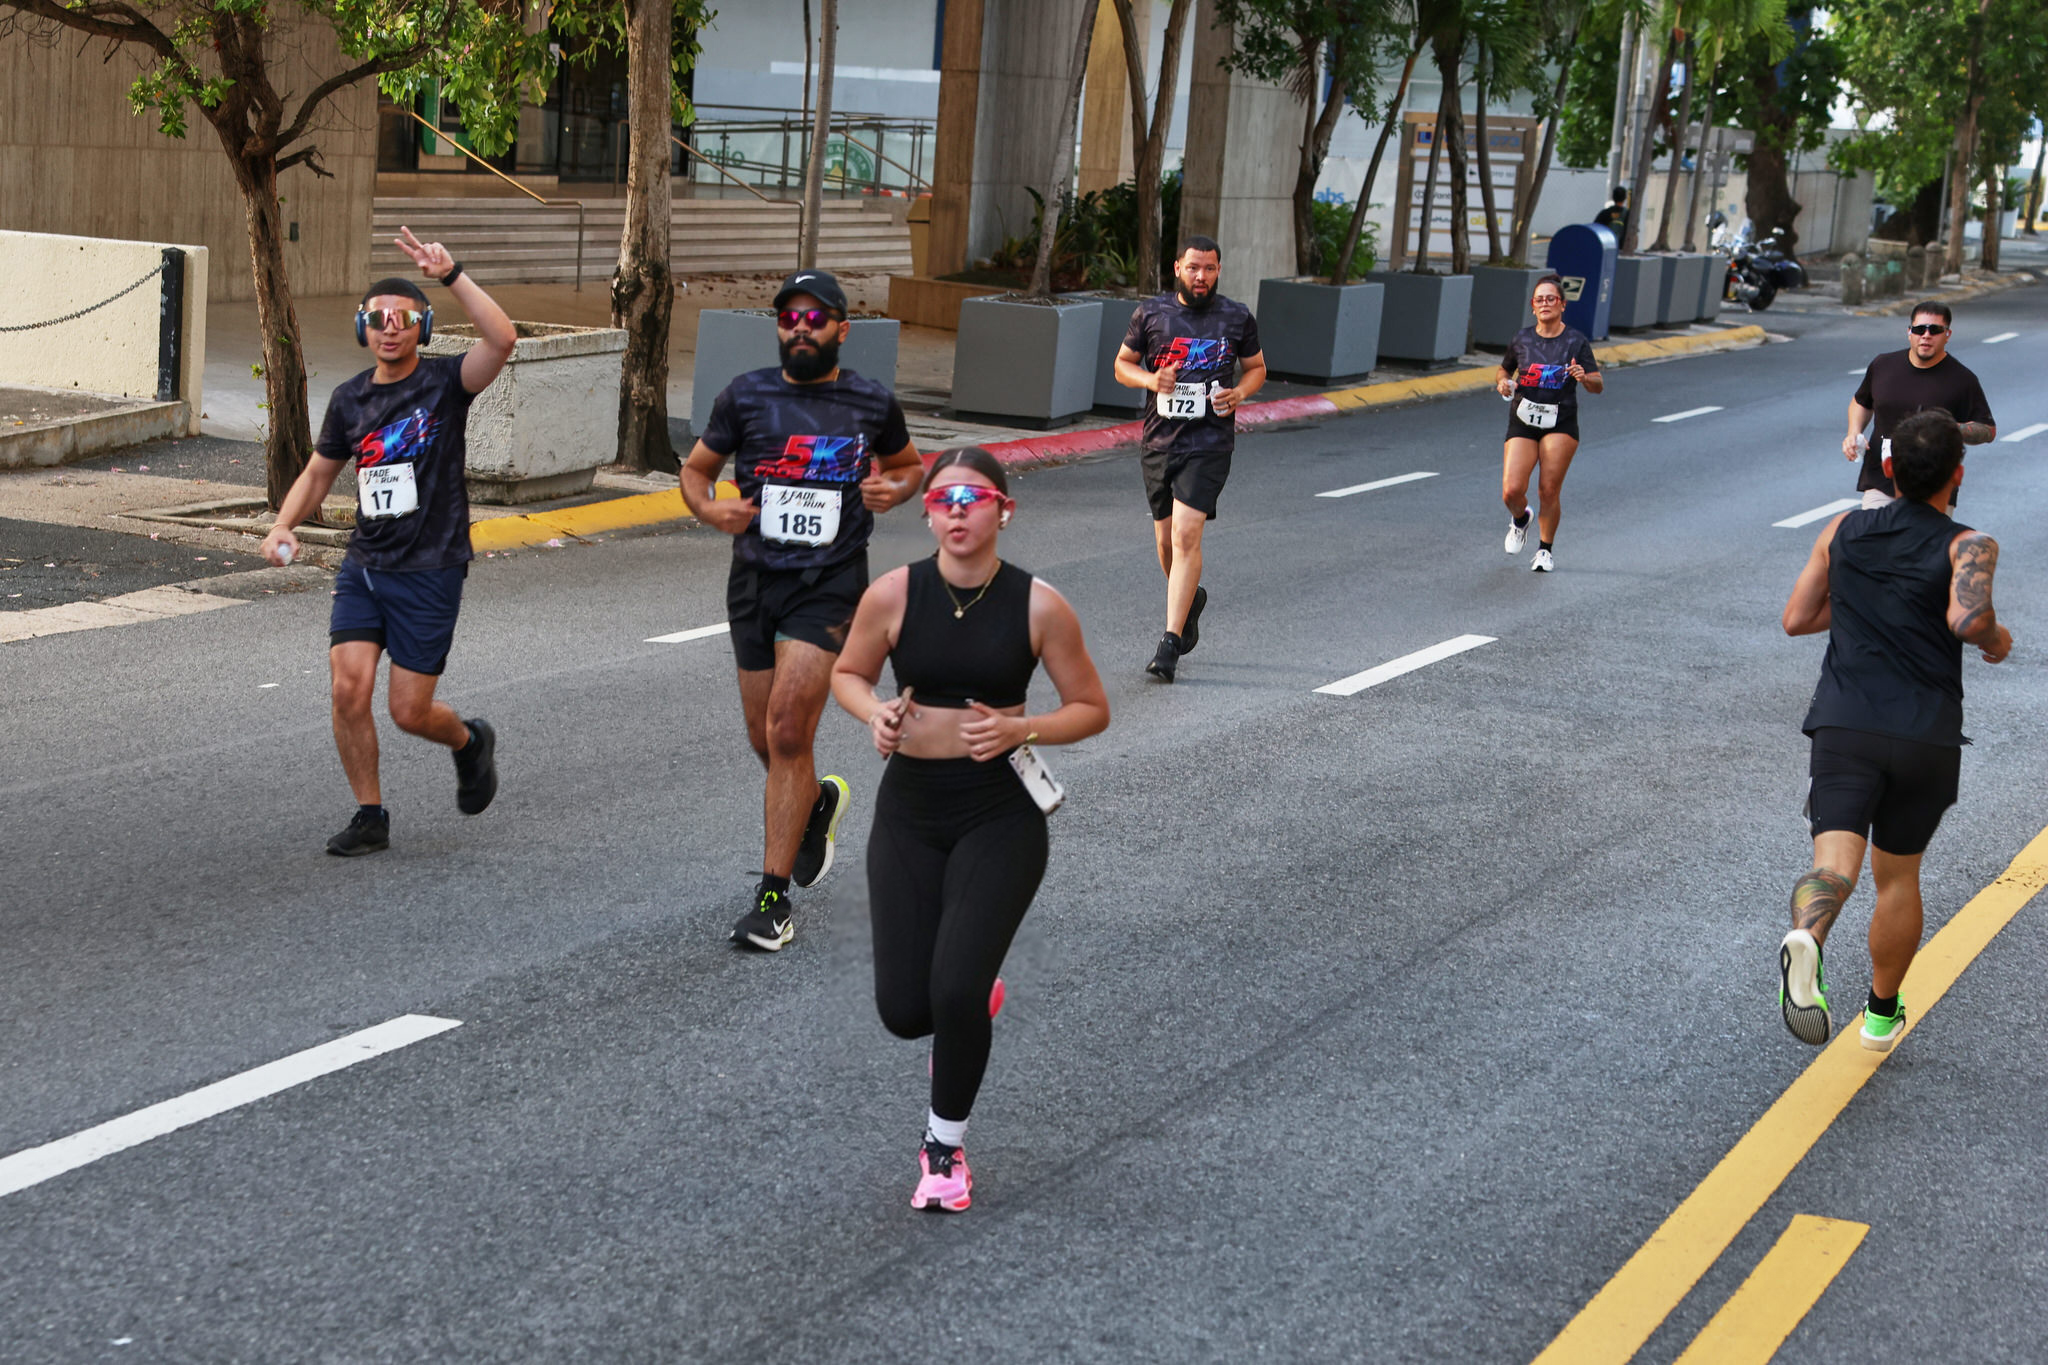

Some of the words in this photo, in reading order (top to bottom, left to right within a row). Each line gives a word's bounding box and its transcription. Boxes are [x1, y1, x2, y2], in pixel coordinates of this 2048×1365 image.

[1168, 337, 1218, 362] 5K
[1526, 364, 1563, 383] 5K
[1167, 398, 1195, 413] 172
[1529, 414, 1542, 424] 11
[360, 417, 411, 462] 5K
[777, 434, 854, 468] 5K
[366, 468, 391, 484] FADE
[381, 476, 399, 484] RUN
[371, 490, 393, 510] 17
[784, 490, 816, 505] FADE
[803, 500, 826, 510] RUN
[779, 512, 822, 536] 185
